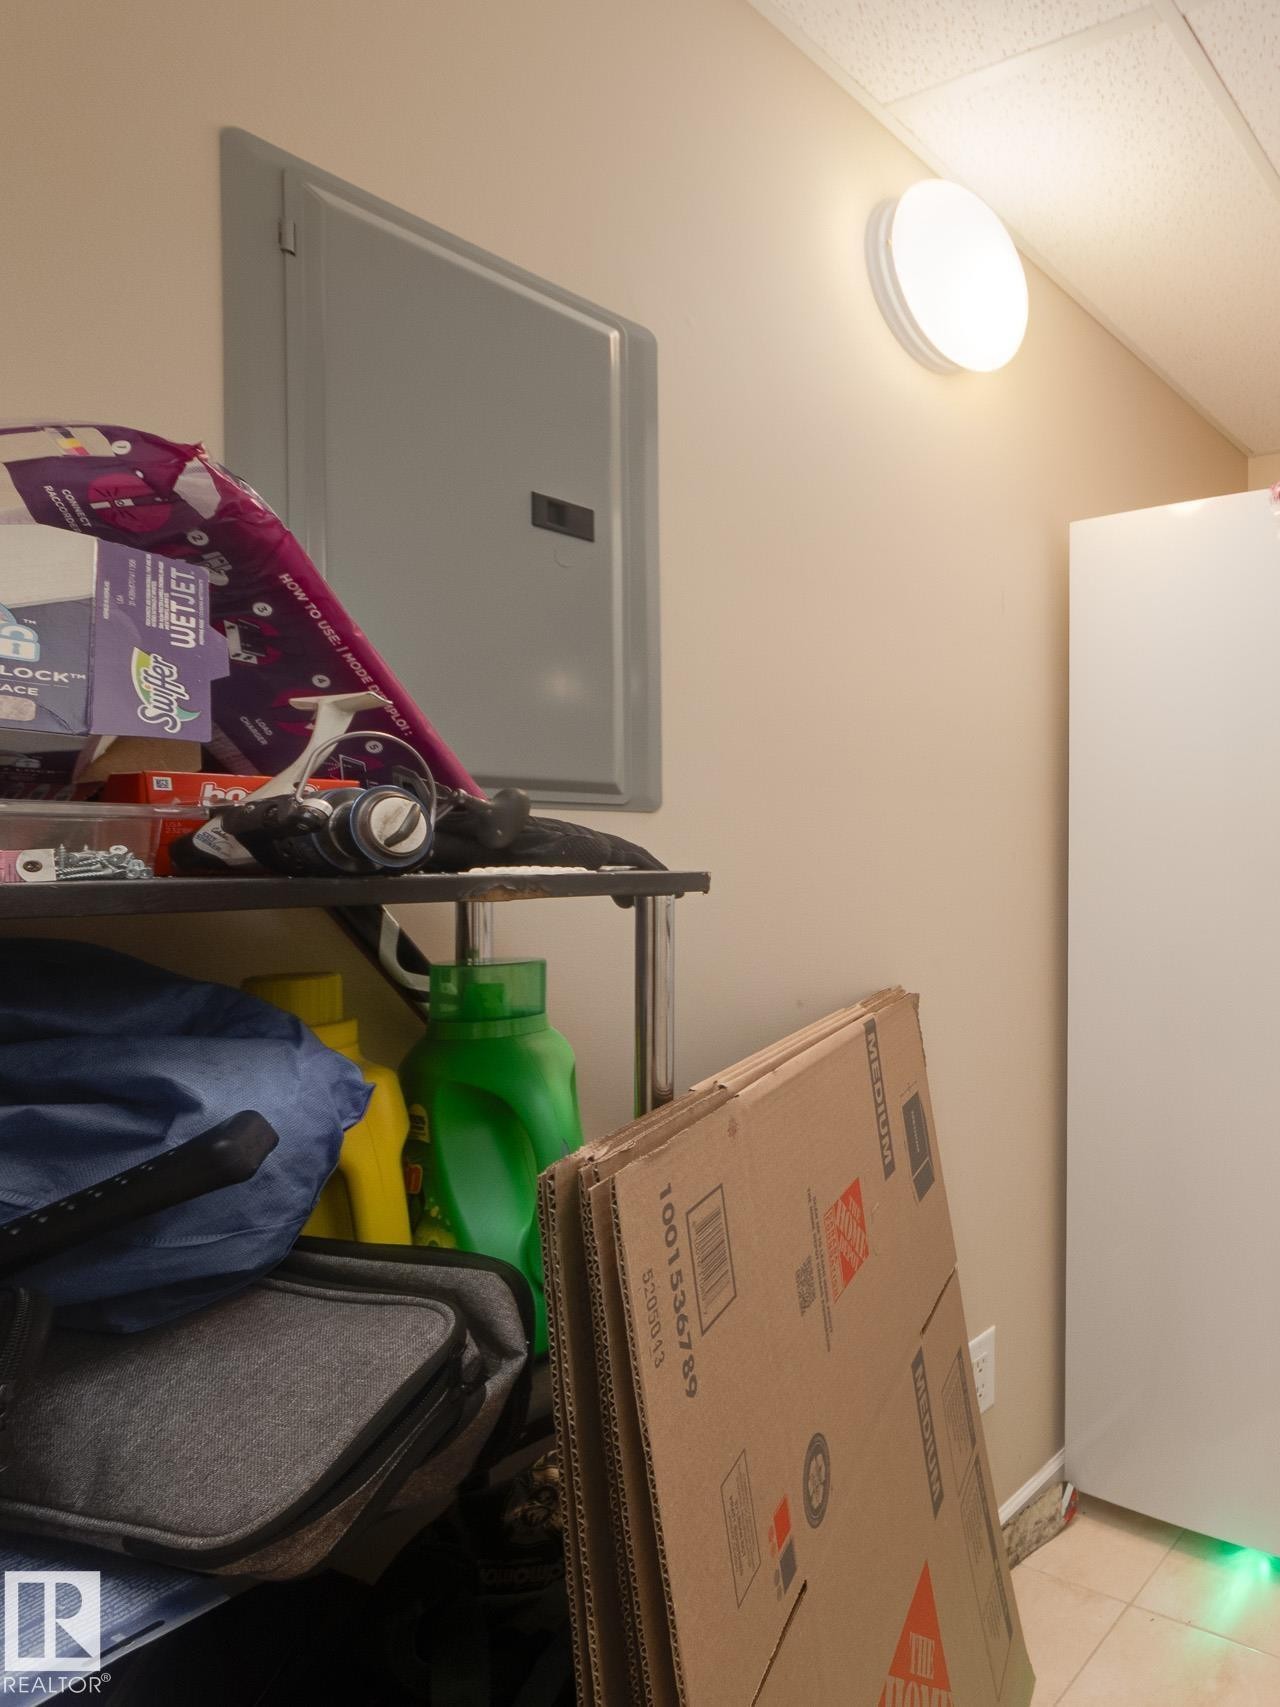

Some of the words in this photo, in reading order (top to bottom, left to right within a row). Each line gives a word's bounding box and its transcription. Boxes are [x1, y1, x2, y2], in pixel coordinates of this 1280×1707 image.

[61, 488, 92, 528] CONNECT
[170, 567, 196, 649] WETJET
[279, 573, 309, 601] HOW
[305, 602, 321, 619] TO
[342, 653, 373, 684] MODE
[0, 683, 39, 696] ACE
[137, 653, 190, 734] Swiffer
[255, 718, 273, 736] LOAD
[240, 715, 268, 746] CHARGER
[867, 1031, 893, 1166] MEDIUM
[659, 1182, 698, 1399] 1001536789
[914, 1363, 940, 1502] MEDIUM
[909, 1631, 935, 1681] THE
